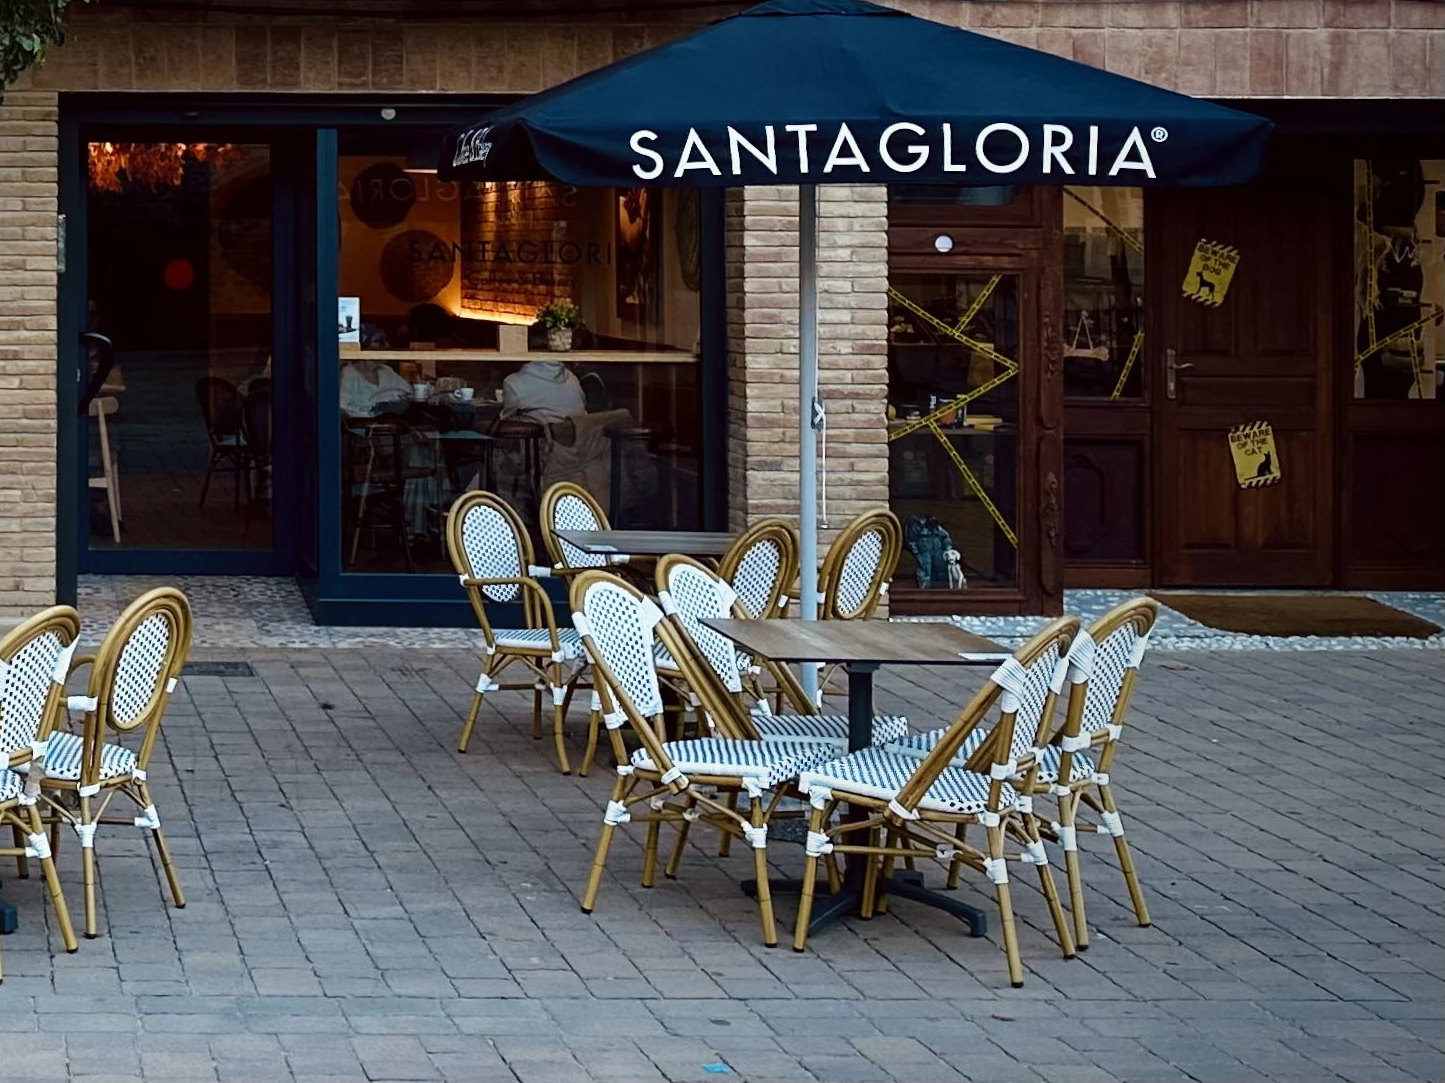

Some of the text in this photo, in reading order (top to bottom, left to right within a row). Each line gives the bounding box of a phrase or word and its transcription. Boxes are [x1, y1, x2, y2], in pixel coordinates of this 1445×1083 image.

[1197, 243, 1237, 264] BEWARE
[1200, 254, 1231, 271] OF THE
[1203, 263, 1222, 275] DOG
[1230, 427, 1271, 443] BEWARE
[1237, 437, 1268, 450] OF THE
[1244, 446, 1263, 456] CAT
